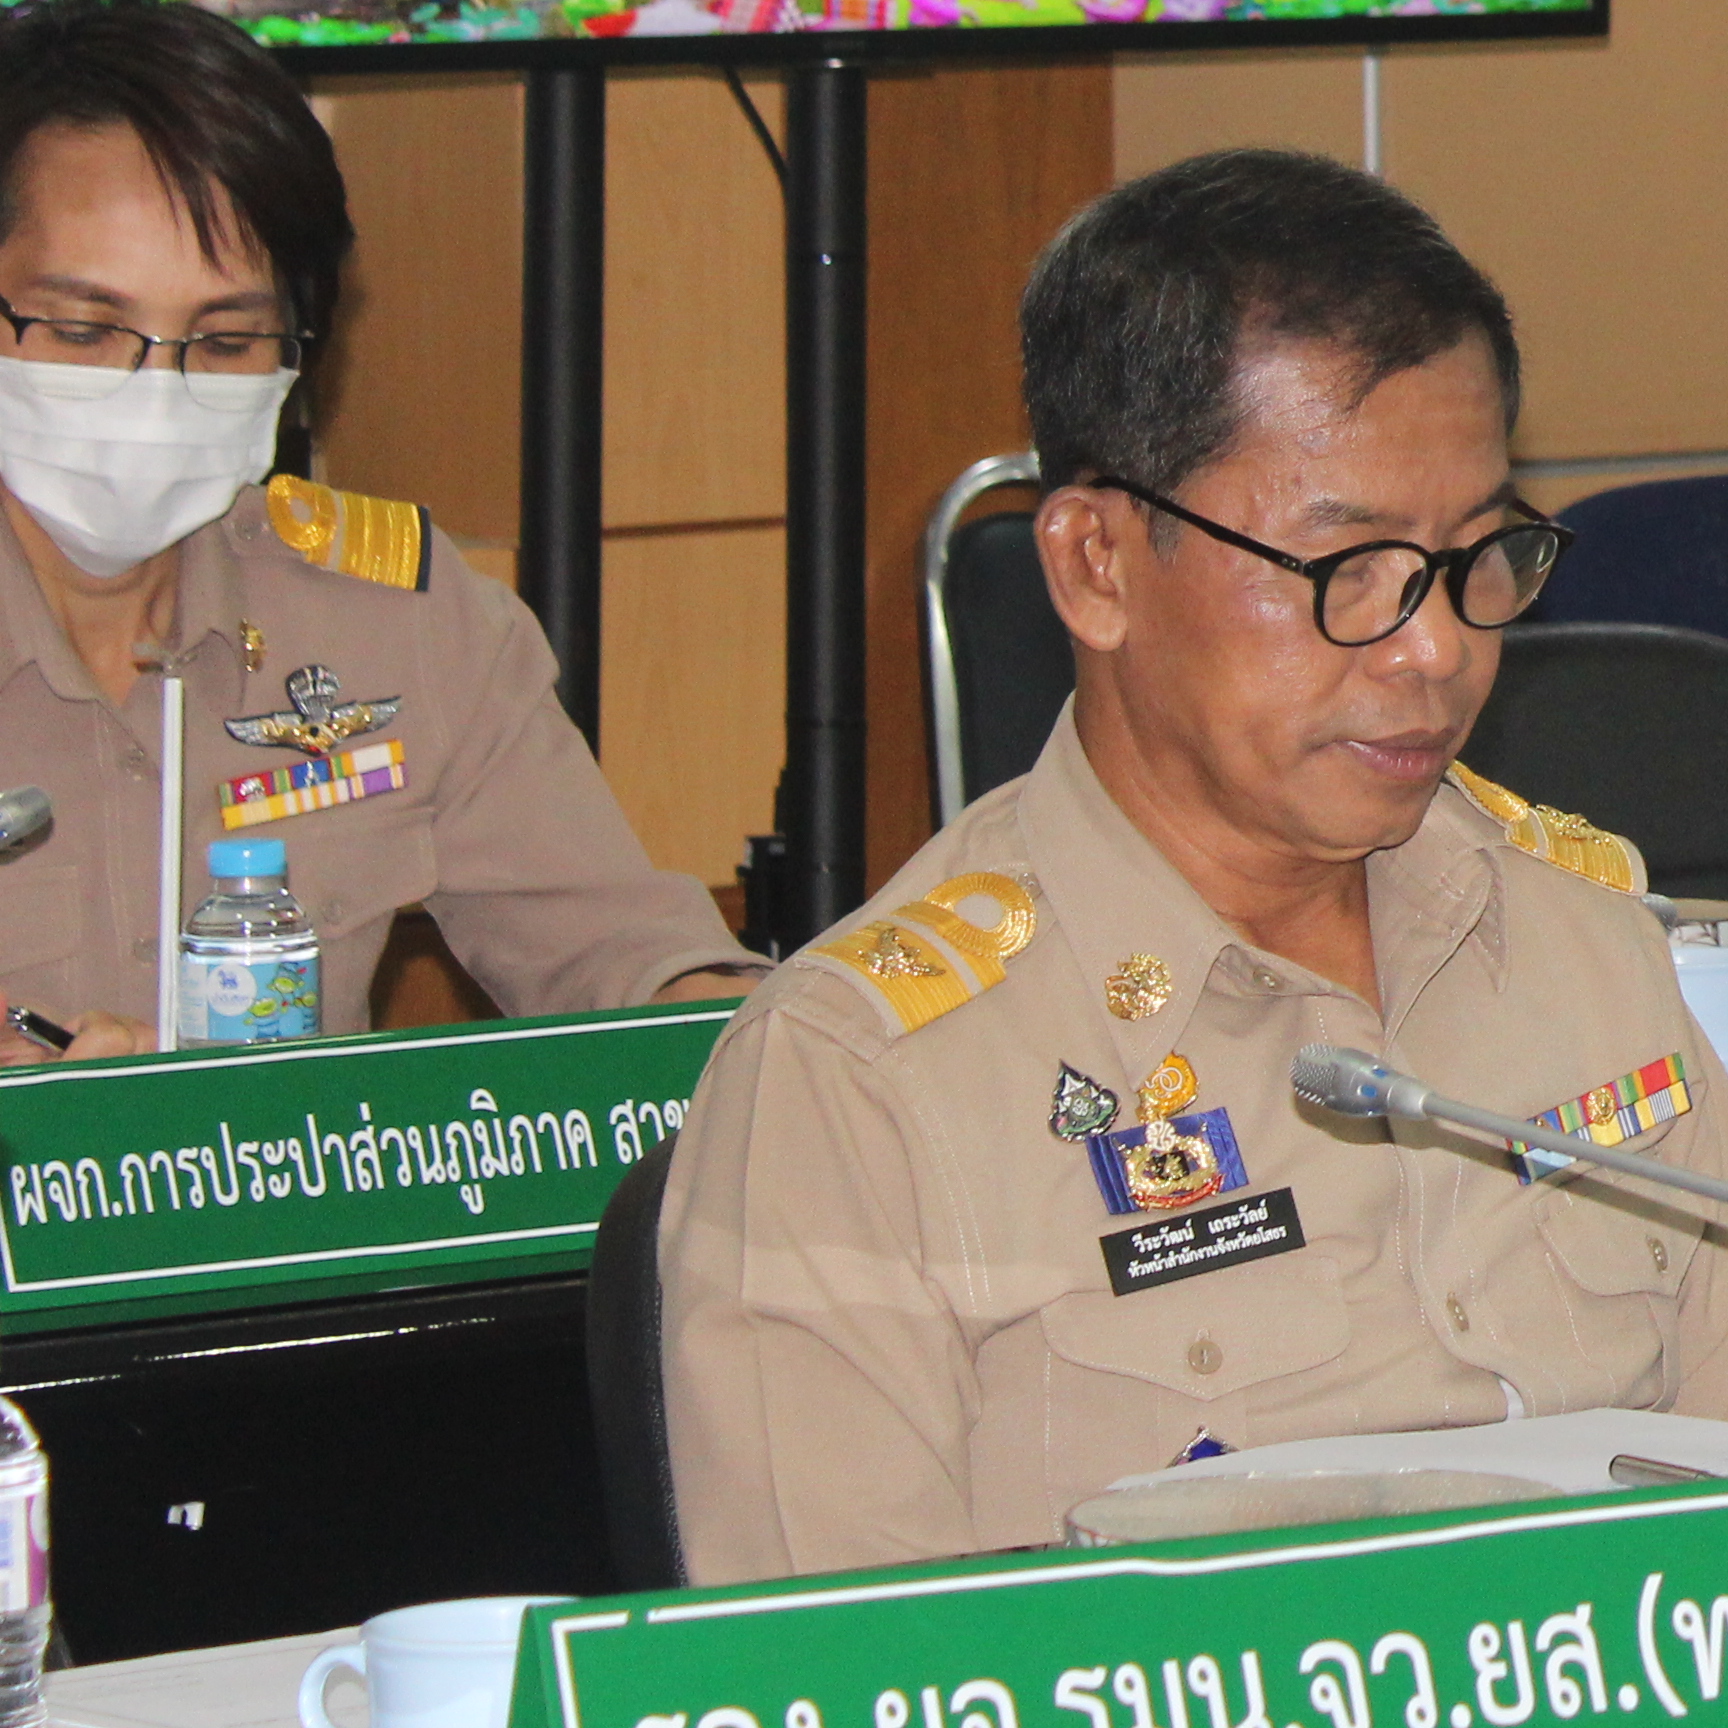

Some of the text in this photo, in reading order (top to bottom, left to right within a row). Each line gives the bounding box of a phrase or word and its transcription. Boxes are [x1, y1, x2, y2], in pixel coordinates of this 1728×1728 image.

[11, 1089, 598, 1226] ผจก.การประปาส่วนภูมิภาค
